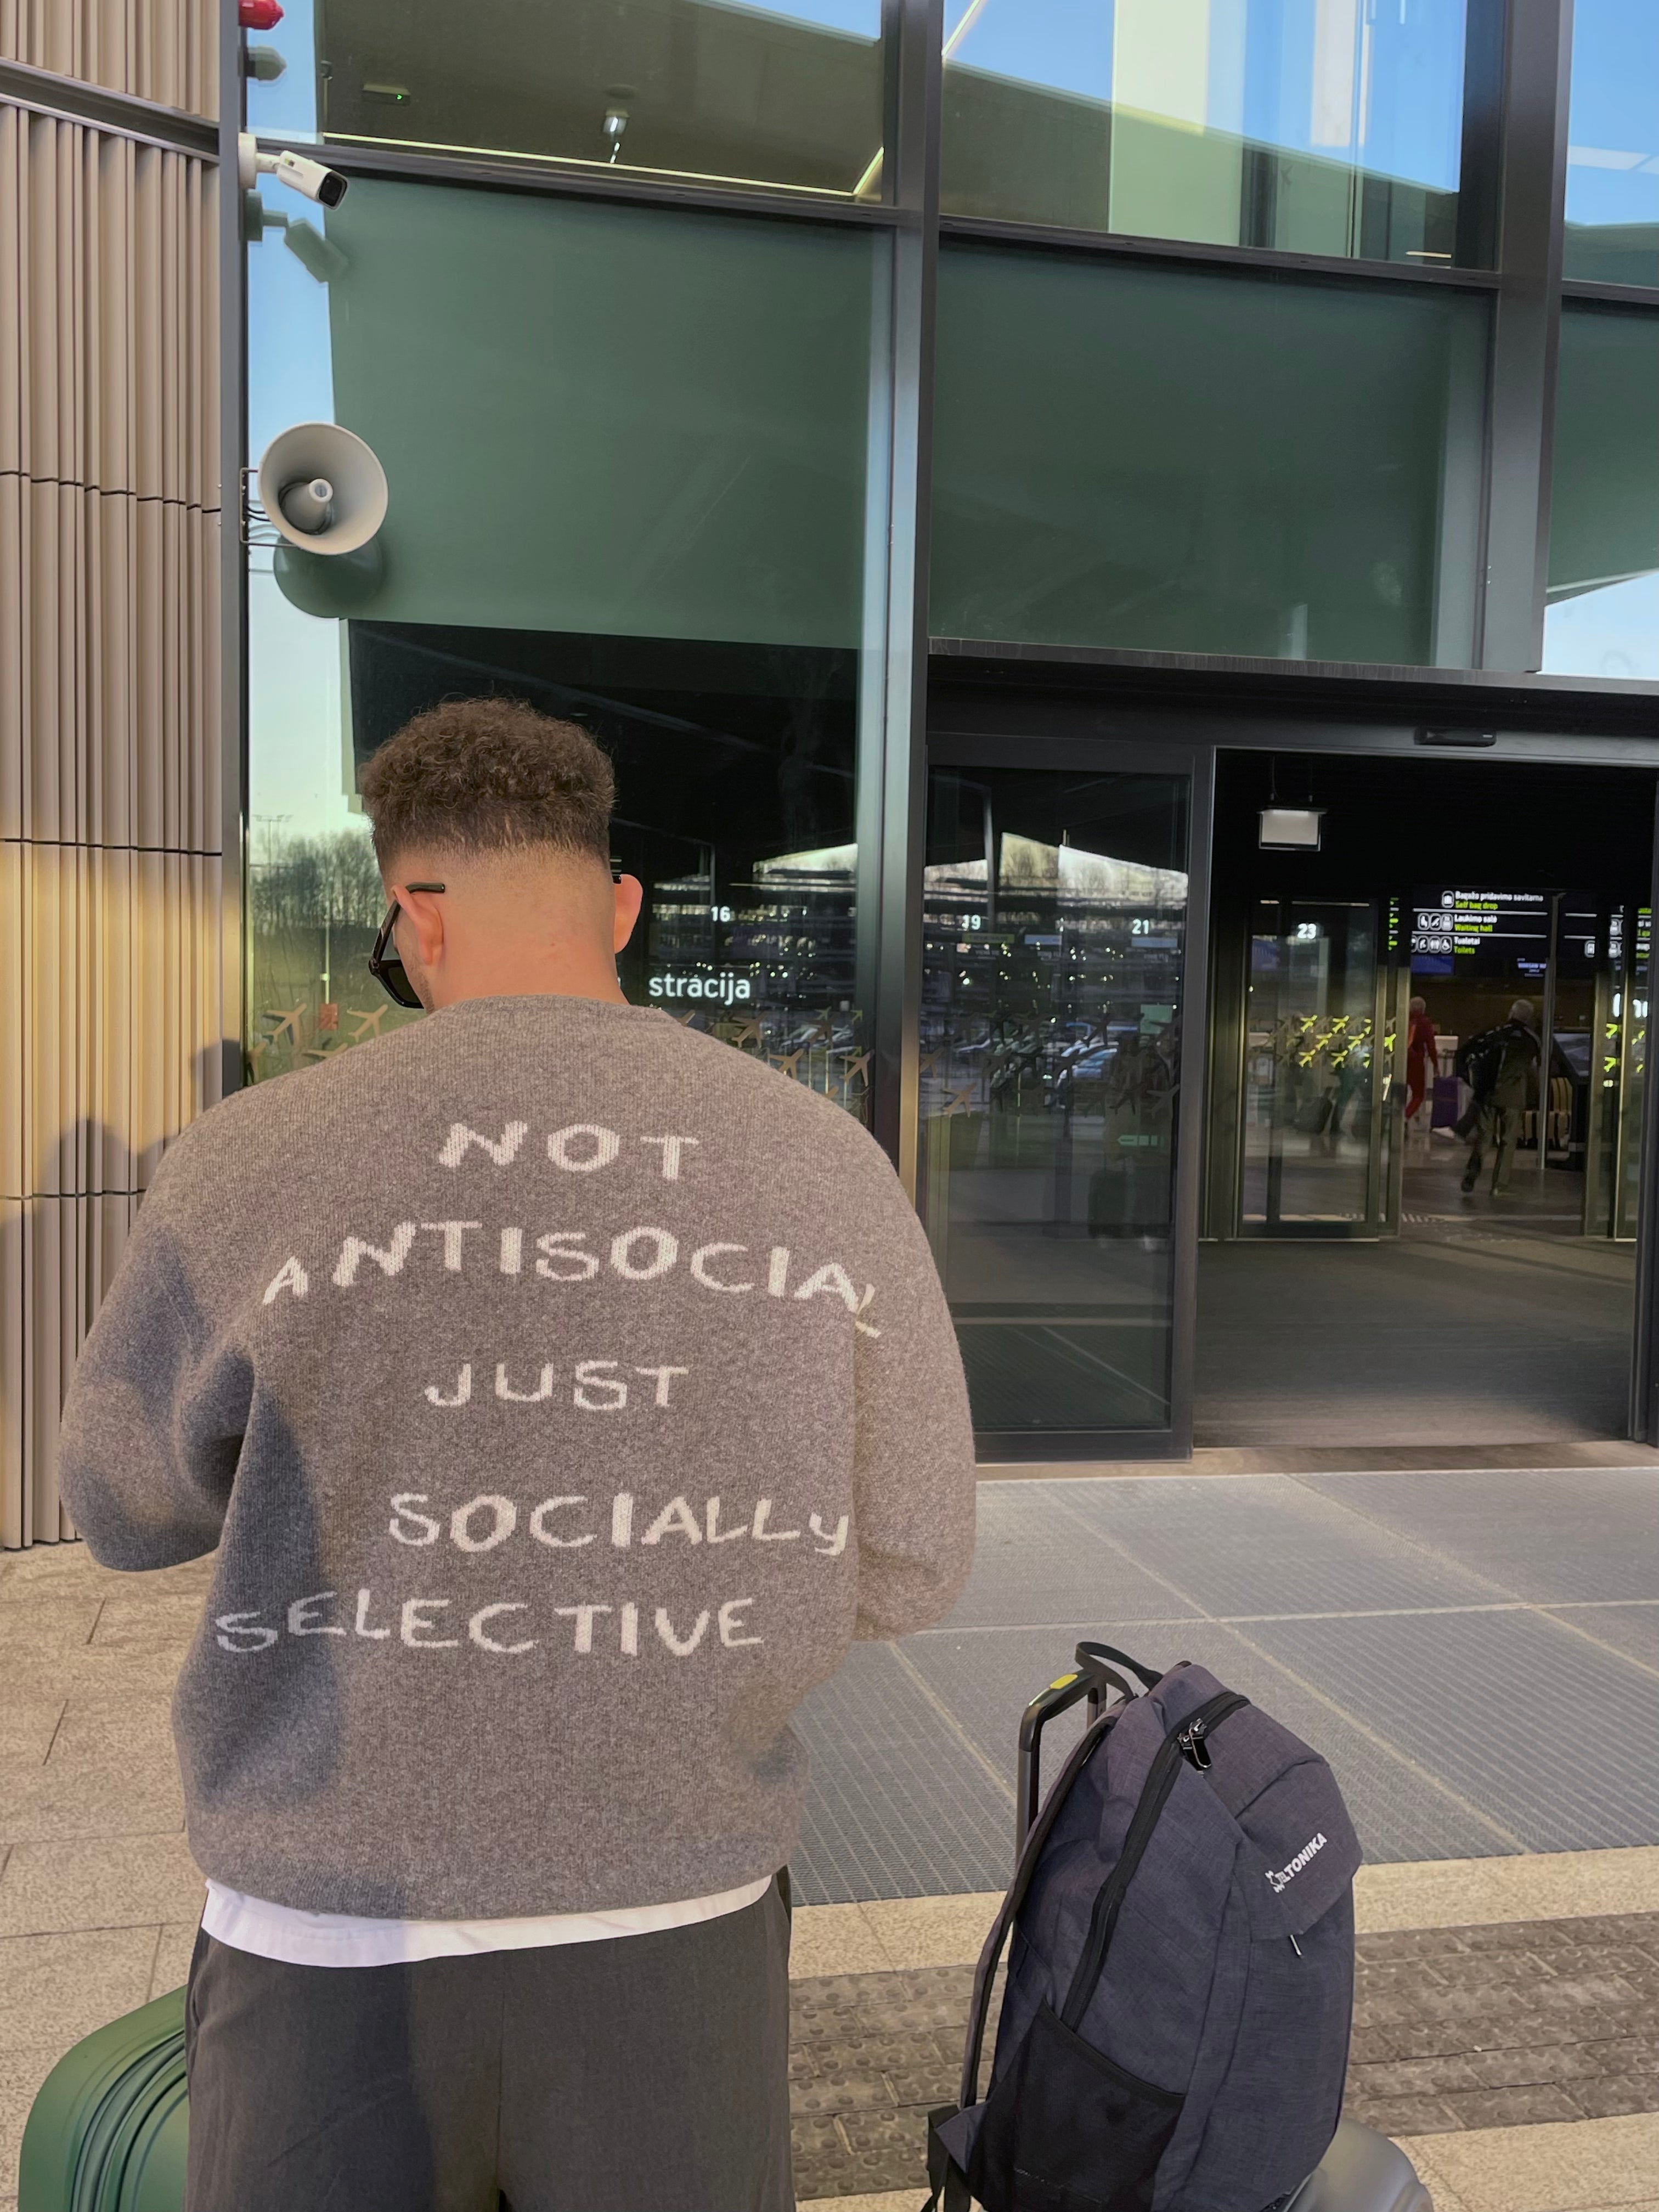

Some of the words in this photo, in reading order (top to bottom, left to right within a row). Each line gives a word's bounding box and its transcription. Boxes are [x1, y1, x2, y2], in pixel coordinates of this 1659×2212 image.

[1455, 900, 1468, 909] Self
[1469, 901, 1482, 910] bag
[1482, 901, 1498, 910] drop
[710, 906, 731, 922] 16
[1132, 918, 1149, 934] 21
[1297, 923, 1317, 939] 23
[1454, 924, 1479, 933] Waiting
[1454, 946, 1476, 955] Toilets
[439, 1120, 699, 1180] NOT
[424, 1359, 689, 1410] JUST
[216, 1589, 764, 1656] SELECTIVE
